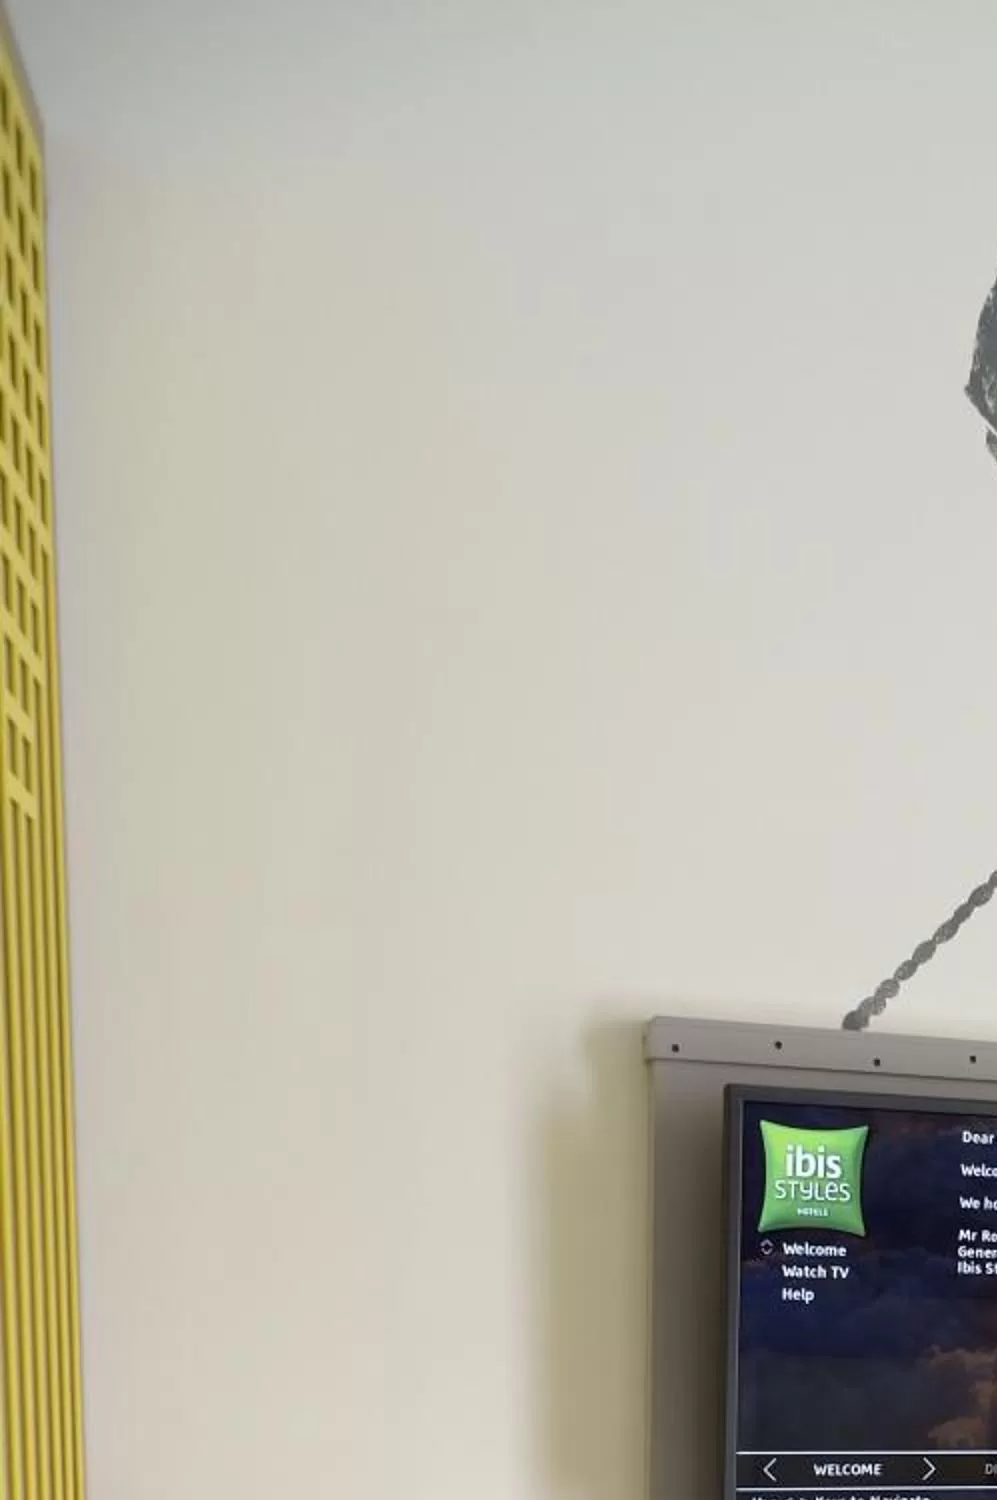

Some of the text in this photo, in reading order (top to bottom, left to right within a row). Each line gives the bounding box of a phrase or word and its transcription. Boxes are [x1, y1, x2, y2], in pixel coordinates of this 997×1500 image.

[962, 1131, 993, 1146] Dear
[785, 1143, 842, 1179] ibis
[959, 1197, 980, 1211] We
[958, 1230, 977, 1242] Mr
[782, 1243, 847, 1257] Welcome
[782, 1265, 849, 1280] Watch TV
[957, 1262, 982, 1276] Ibis
[782, 1287, 815, 1305] Help
[813, 1463, 883, 1477] WELCOME
